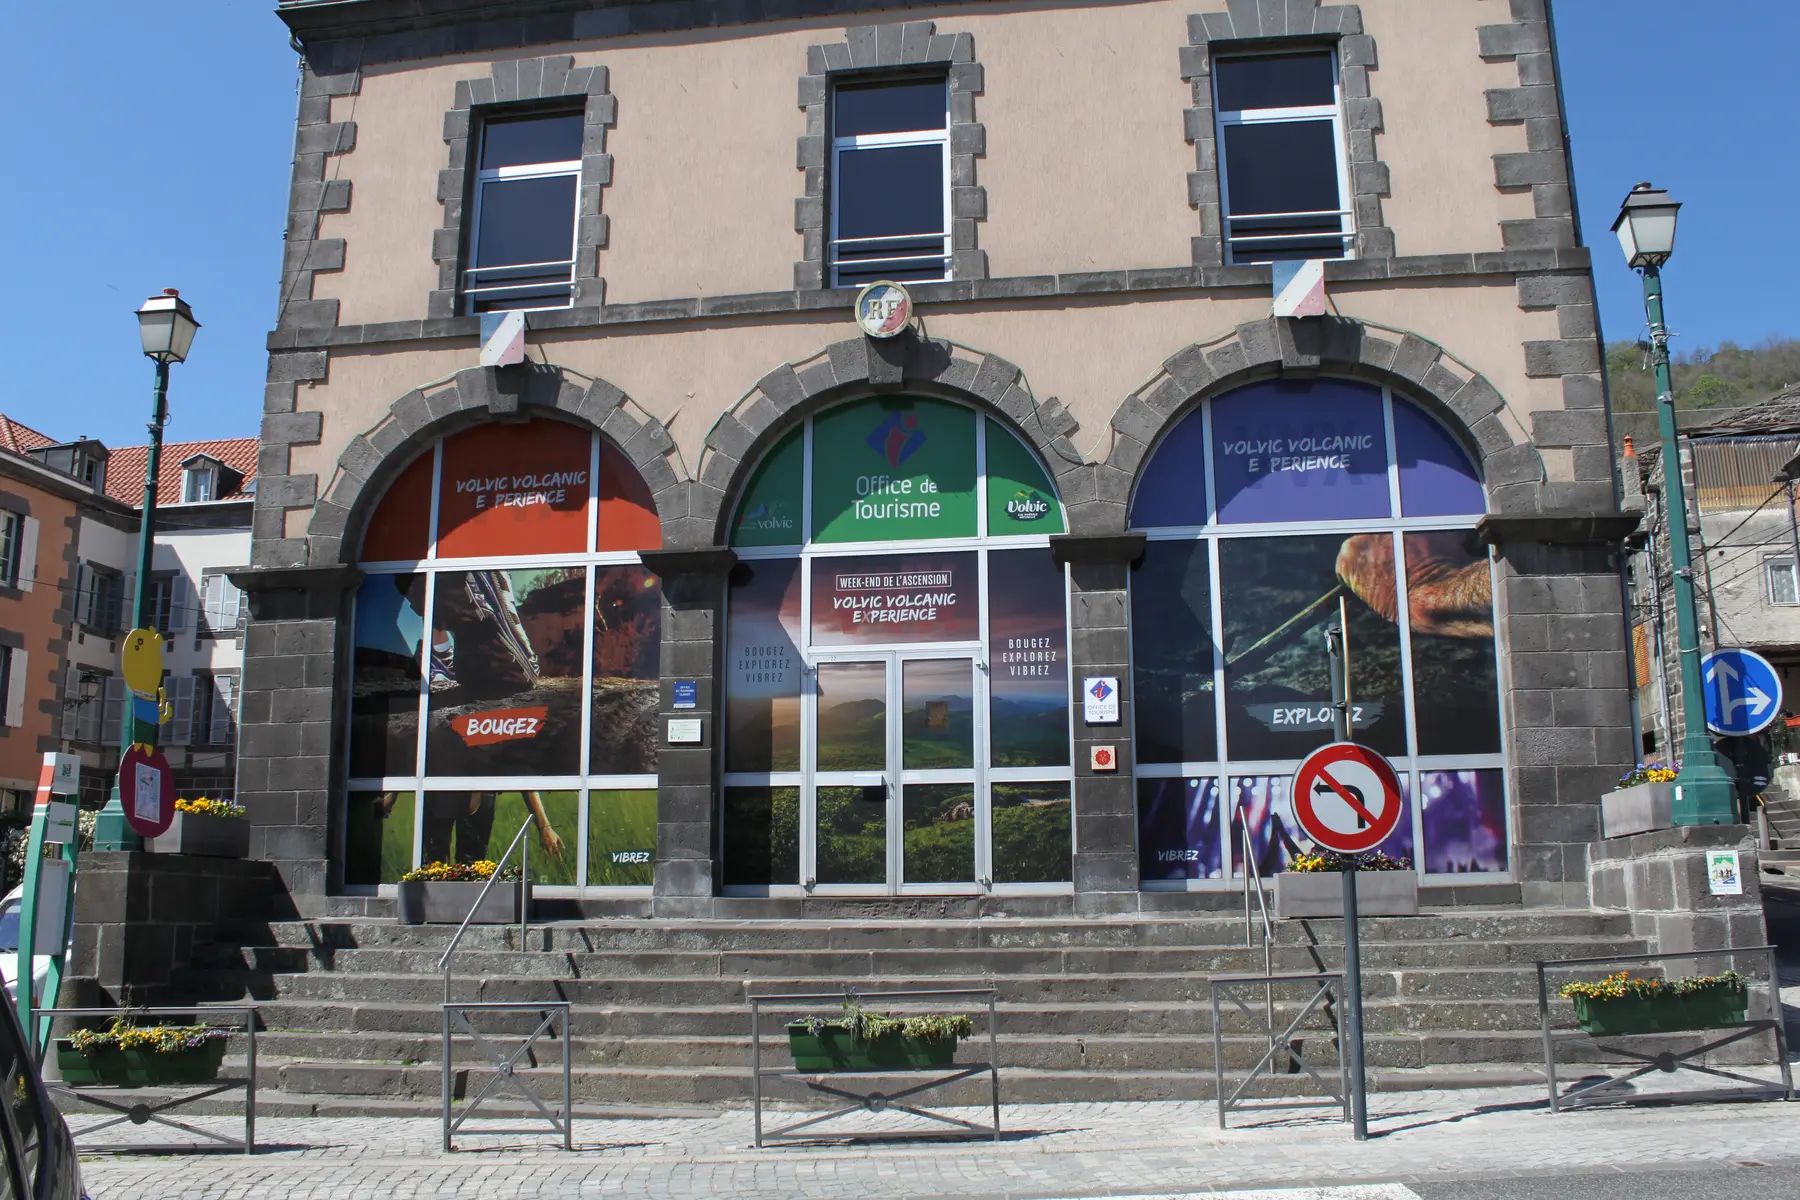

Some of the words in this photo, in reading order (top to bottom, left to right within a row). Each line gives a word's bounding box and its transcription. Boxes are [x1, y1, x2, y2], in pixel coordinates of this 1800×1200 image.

[868, 299, 900, 320] RF
[1223, 439, 1283, 455] VOLVIC
[1288, 435, 1373, 453] VOLCANIC
[456, 477, 508, 493] VOLVIC
[512, 471, 587, 489] VOLCANIC
[856, 475, 912, 496] Office
[920, 478, 937, 494] de
[851, 498, 941, 520] Tourisme
[1008, 499, 1047, 513] Volvic
[757, 516, 793, 529] volvic
[840, 577, 881, 588] WEEK-END
[884, 576, 894, 587] DE
[833, 595, 882, 609] VOLVIC
[886, 593, 957, 608] VOLCANIC
[852, 608, 937, 624] EXPERIENCE
[1008, 638, 1050, 649] BOUGEZ
[745, 646, 784, 656] BOUGEZ
[1002, 651, 1057, 663] EXPLOREZ
[739, 659, 790, 670] EXPLOREZ
[1010, 665, 1049, 676] VIBREZ
[745, 672, 783, 683] VIBREZ
[1273, 706, 1363, 725] EXPLOZ
[466, 717, 538, 736] BOUGEZ
[612, 851, 650, 864] VIBREZ
[1157, 849, 1200, 862] VIBREZ
